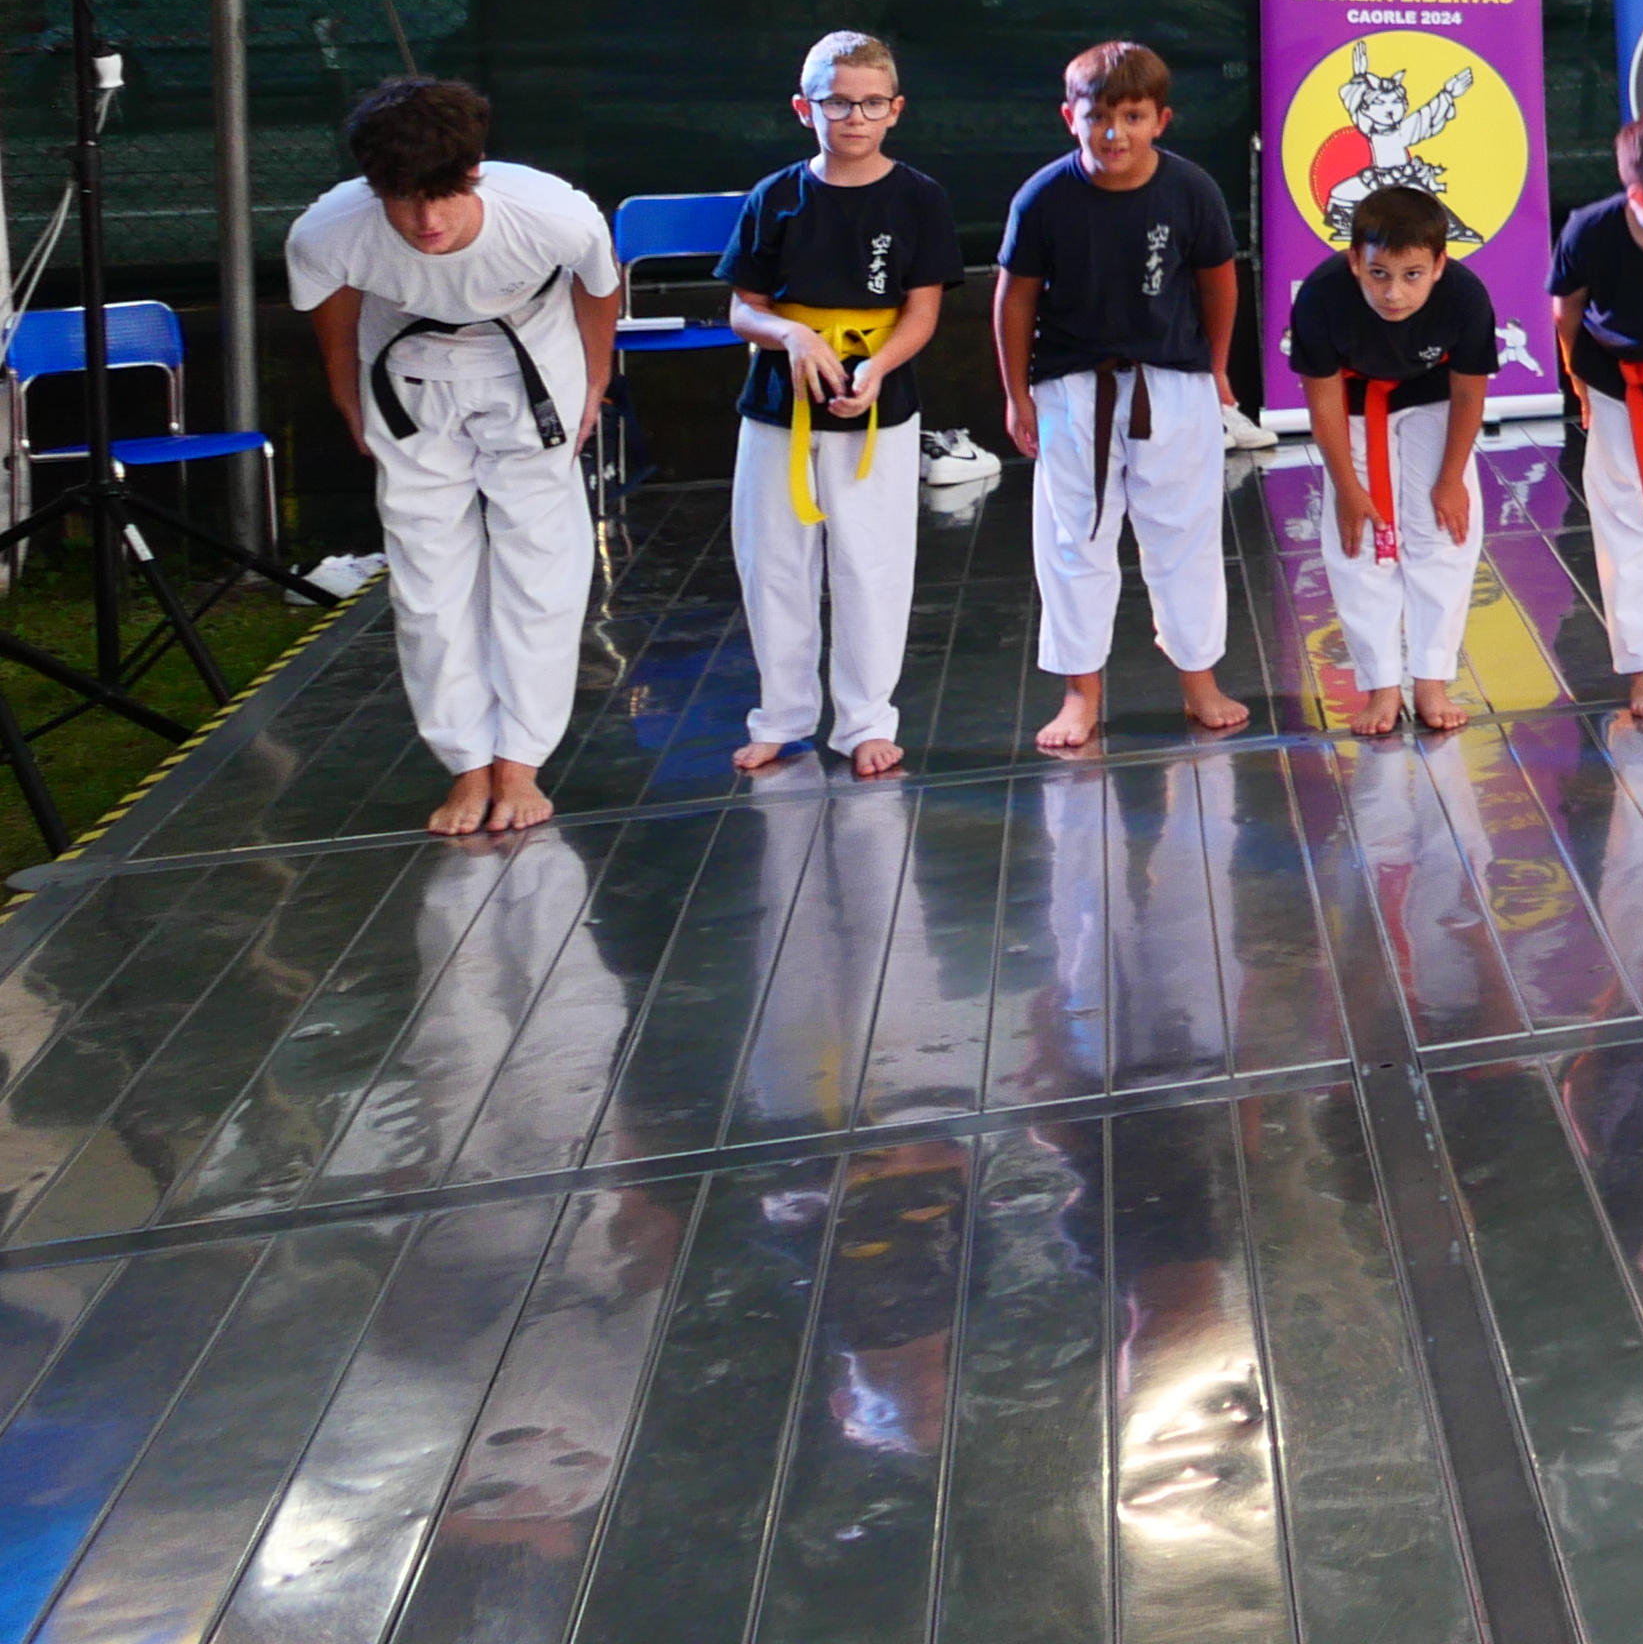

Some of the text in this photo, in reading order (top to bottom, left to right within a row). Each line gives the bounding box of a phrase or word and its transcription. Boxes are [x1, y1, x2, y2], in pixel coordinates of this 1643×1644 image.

[1347, 9, 1463, 25] CAORLE 2024
[867, 233, 892, 295] 空手道
